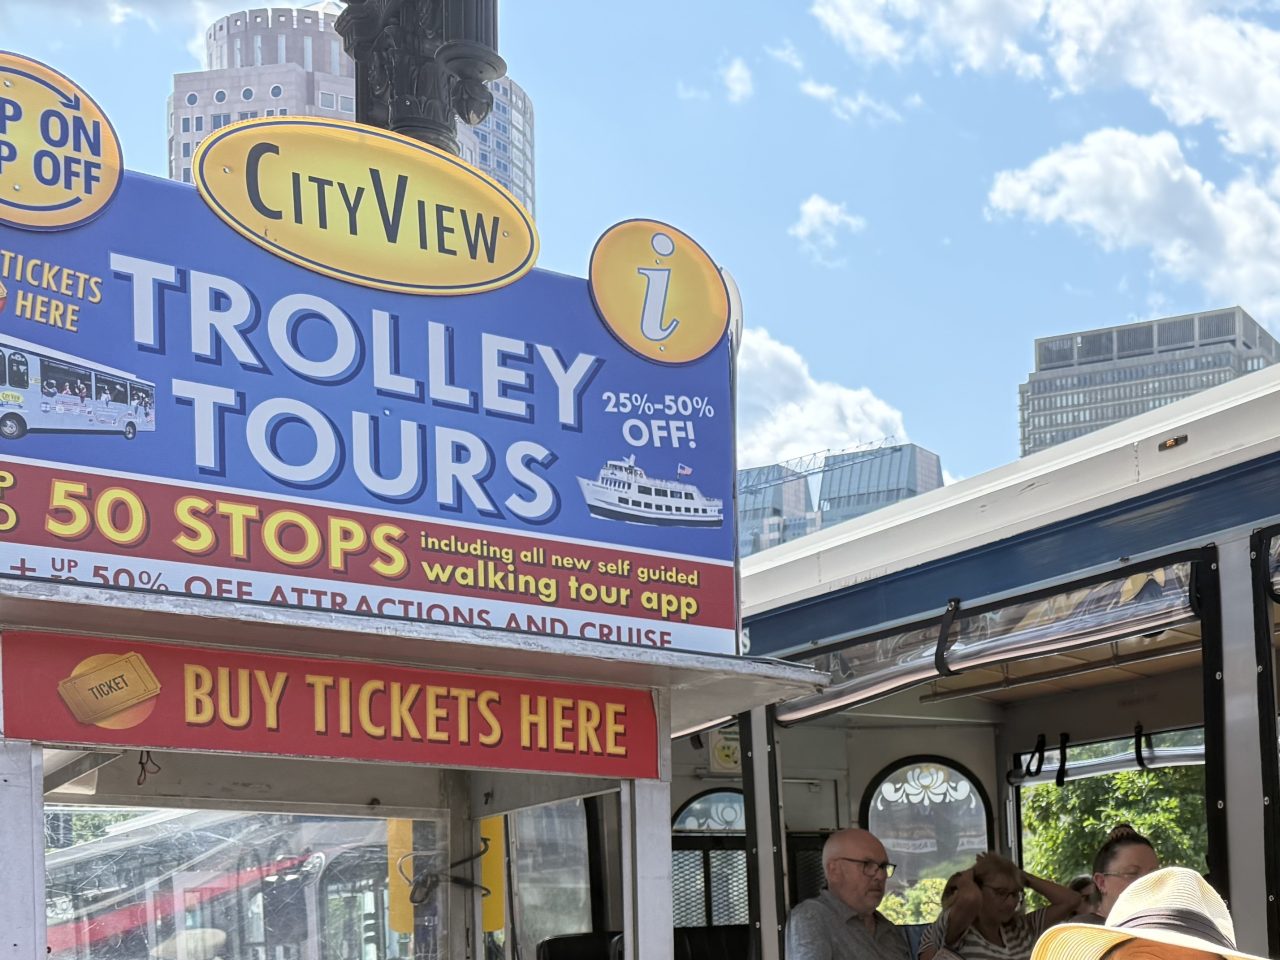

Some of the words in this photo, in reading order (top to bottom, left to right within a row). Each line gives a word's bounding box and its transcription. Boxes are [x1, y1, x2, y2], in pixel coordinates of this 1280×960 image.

[40, 109, 101, 157] ON
[34, 150, 102, 195] OFF
[2, 252, 103, 304] TICKETS
[15, 289, 79, 332] HERE
[110, 252, 600, 428] TROLLEY
[602, 391, 715, 418] 25%-50%
[172, 378, 555, 520] TOURS
[622, 419, 697, 450] OFF!
[46, 478, 147, 545] 50
[172, 496, 408, 578] STOPS
[51, 557, 78, 573] UP
[420, 532, 513, 562] including
[520, 548, 544, 565] all
[551, 553, 591, 571] new
[598, 559, 630, 576] self
[637, 566, 698, 587] guided
[421, 558, 557, 603] walking
[568, 575, 630, 606] tour
[640, 590, 698, 620] app
[505, 612, 569, 637] AND
[88, 674, 129, 700] TICKET
[183, 663, 288, 731] BUY
[306, 673, 502, 746] TICKETS
[520, 694, 628, 756] HERE
